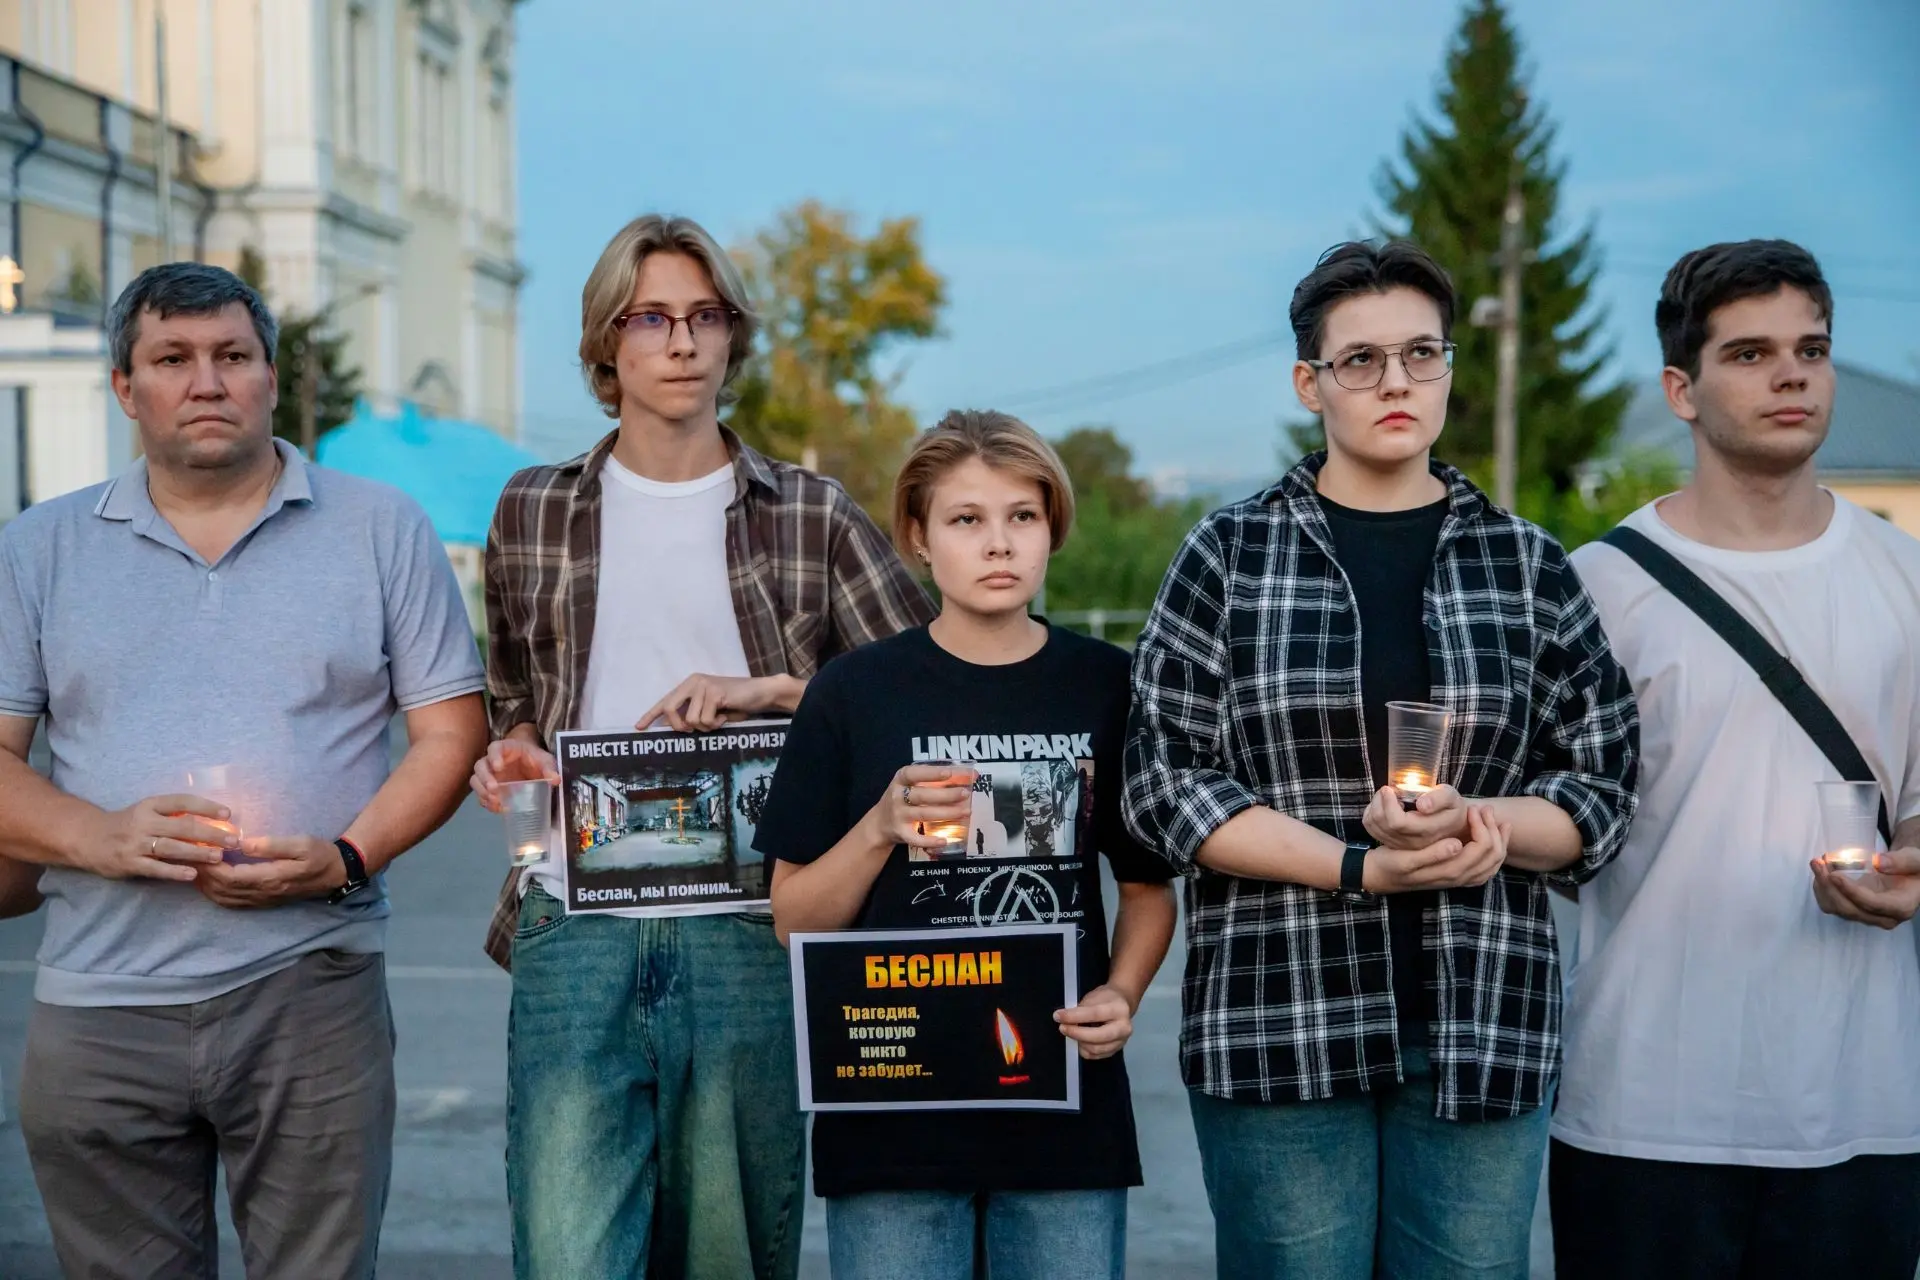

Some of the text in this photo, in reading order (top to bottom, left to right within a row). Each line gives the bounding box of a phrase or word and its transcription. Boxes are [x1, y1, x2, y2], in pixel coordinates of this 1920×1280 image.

[568, 740, 629, 759] ВМЕСТЕ
[632, 737, 696, 756] ПРОТИВ
[910, 869, 925, 877] JOE
[926, 868, 950, 876] HAHN
[957, 866, 992, 874] PHOENIX
[998, 864, 1017, 872] MIKE
[1018, 863, 1054, 872] SHINODA
[576, 881, 743, 902] Беслан, мы помним...
[931, 915, 968, 925] CHESTER
[865, 951, 1003, 989] БЕСЛАН
[842, 1005, 920, 1022] Трагедия,
[848, 1026, 917, 1040] которую
[859, 1045, 907, 1059] никто
[836, 1063, 933, 1079] не забудет...
